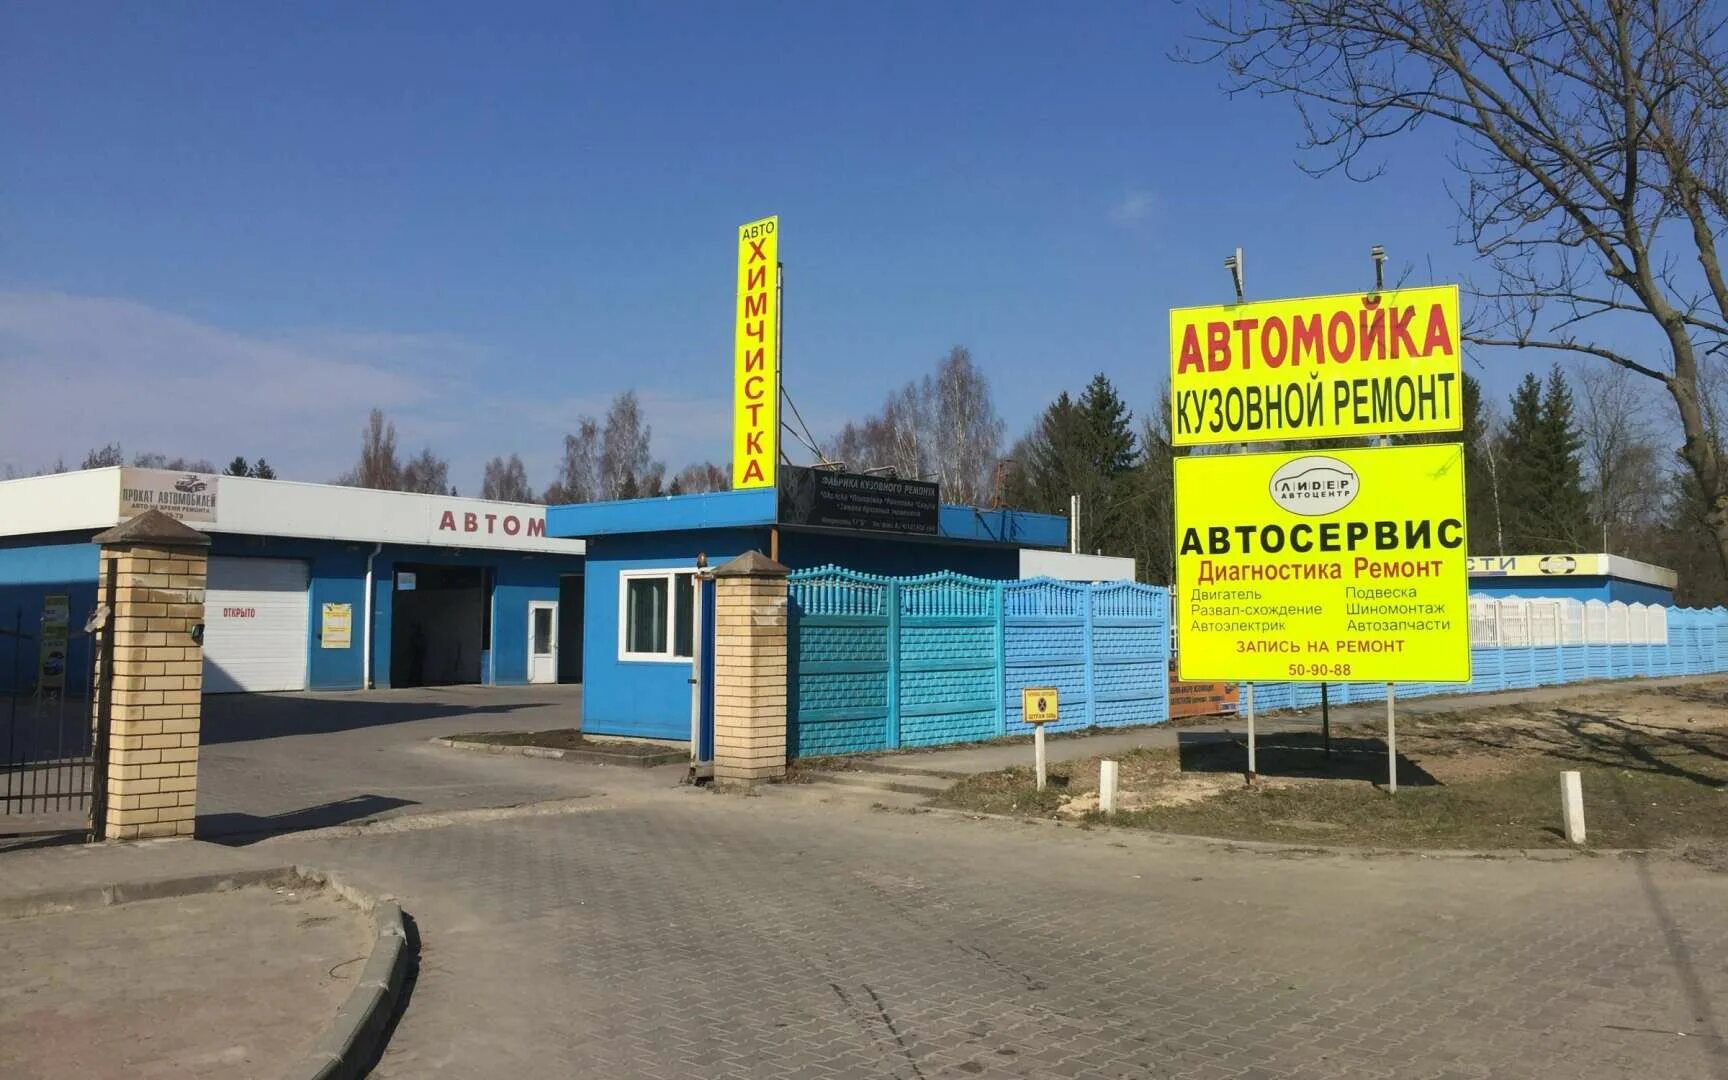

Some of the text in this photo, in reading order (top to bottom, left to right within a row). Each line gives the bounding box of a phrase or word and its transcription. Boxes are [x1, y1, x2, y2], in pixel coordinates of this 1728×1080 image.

[742, 220, 775, 241] АВТО
[1177, 295, 1454, 374] АВТОМОЙКА
[742, 238, 767, 484] ХИМЧИСТКА
[1177, 371, 1455, 434] КУЗОВНОЙ РЕМОНТ
[122, 488, 153, 503] ПРОКАТ
[1281, 490, 1350, 499] АВТОЦЕНТР
[438, 510, 546, 537] АВТОМ
[1180, 518, 1463, 555] АВТОСЕРВИС
[1198, 557, 1443, 585] Диагностика Ремонт
[1191, 588, 1262, 602] Двигатель
[1346, 586, 1417, 600] Подвеска
[223, 607, 256, 618] ОТКРЫТО
[1191, 603, 1323, 617] Развал-схождение
[1346, 602, 1445, 616] Шиномонтаж
[1191, 619, 1286, 633] Автоэлектрик
[1347, 618, 1451, 632] Автозапчасти
[1236, 639, 1405, 653] ЗАПИСЬ НА РЕМОНТ
[1288, 663, 1351, 676] 50-90-88
